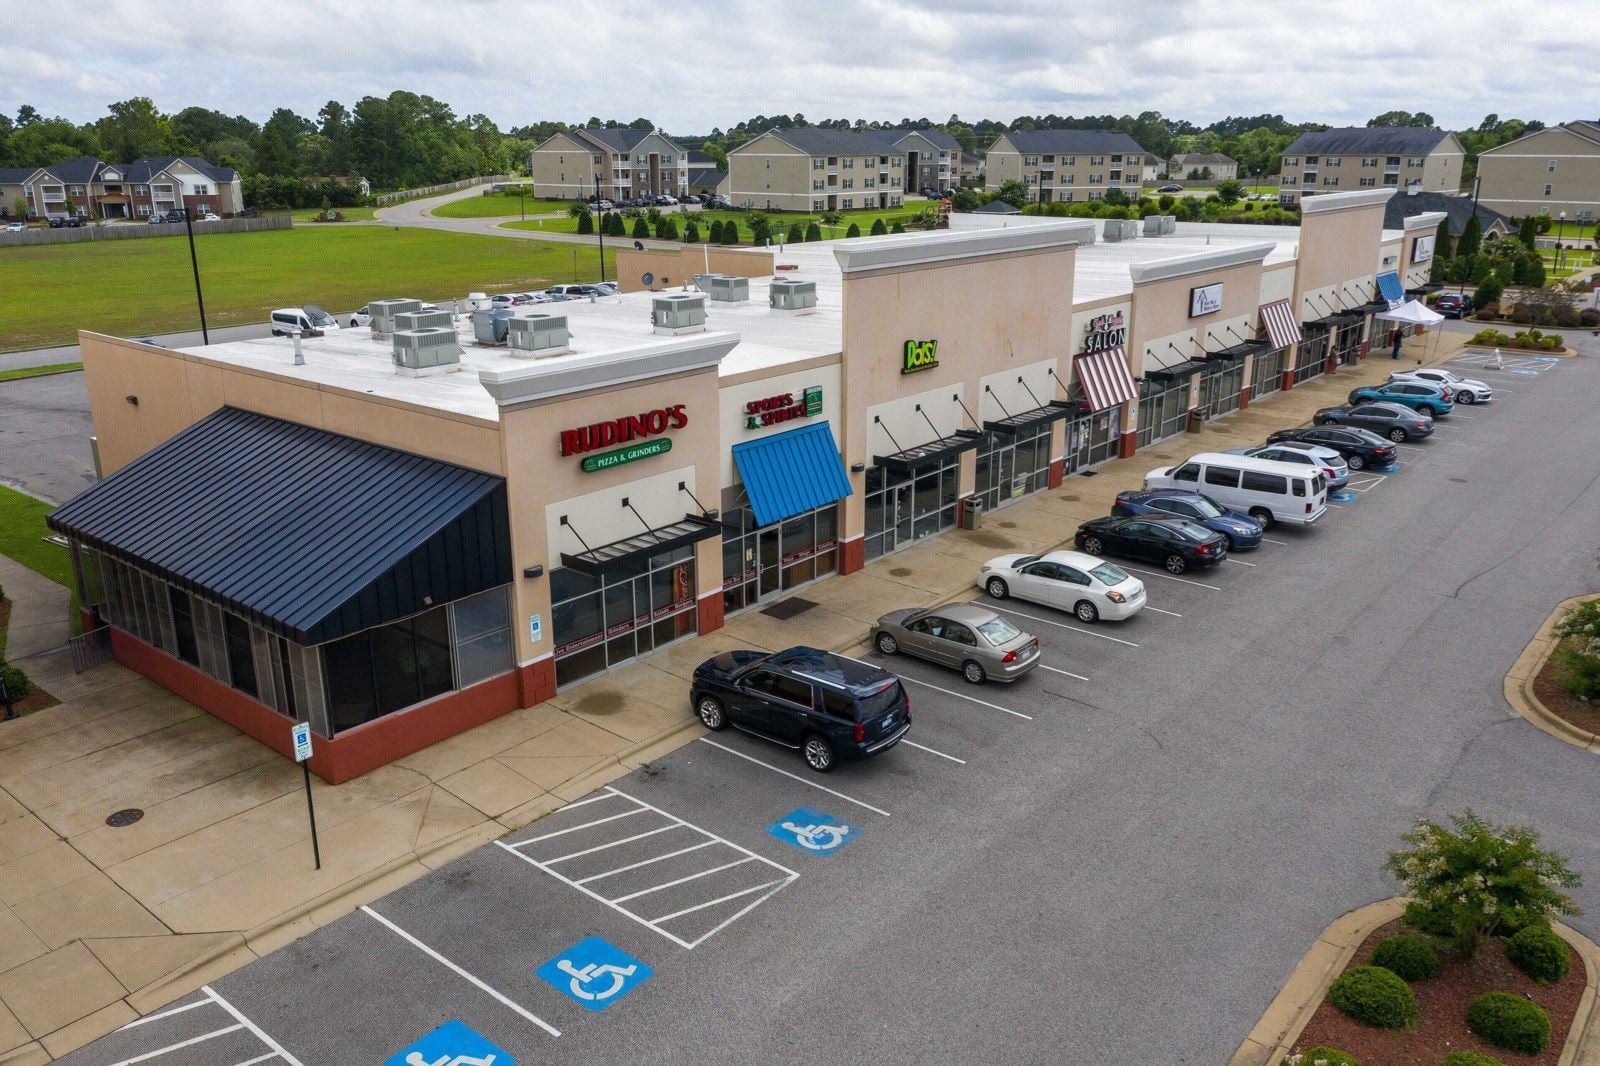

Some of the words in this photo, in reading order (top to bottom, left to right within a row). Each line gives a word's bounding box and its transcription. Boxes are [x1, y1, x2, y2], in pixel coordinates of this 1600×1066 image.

[1085, 328, 1126, 352] SALON
[560, 404, 688, 457] RUDINO'S
[598, 456, 618, 468] PIZZA
[628, 444, 661, 459] GRINDERS
